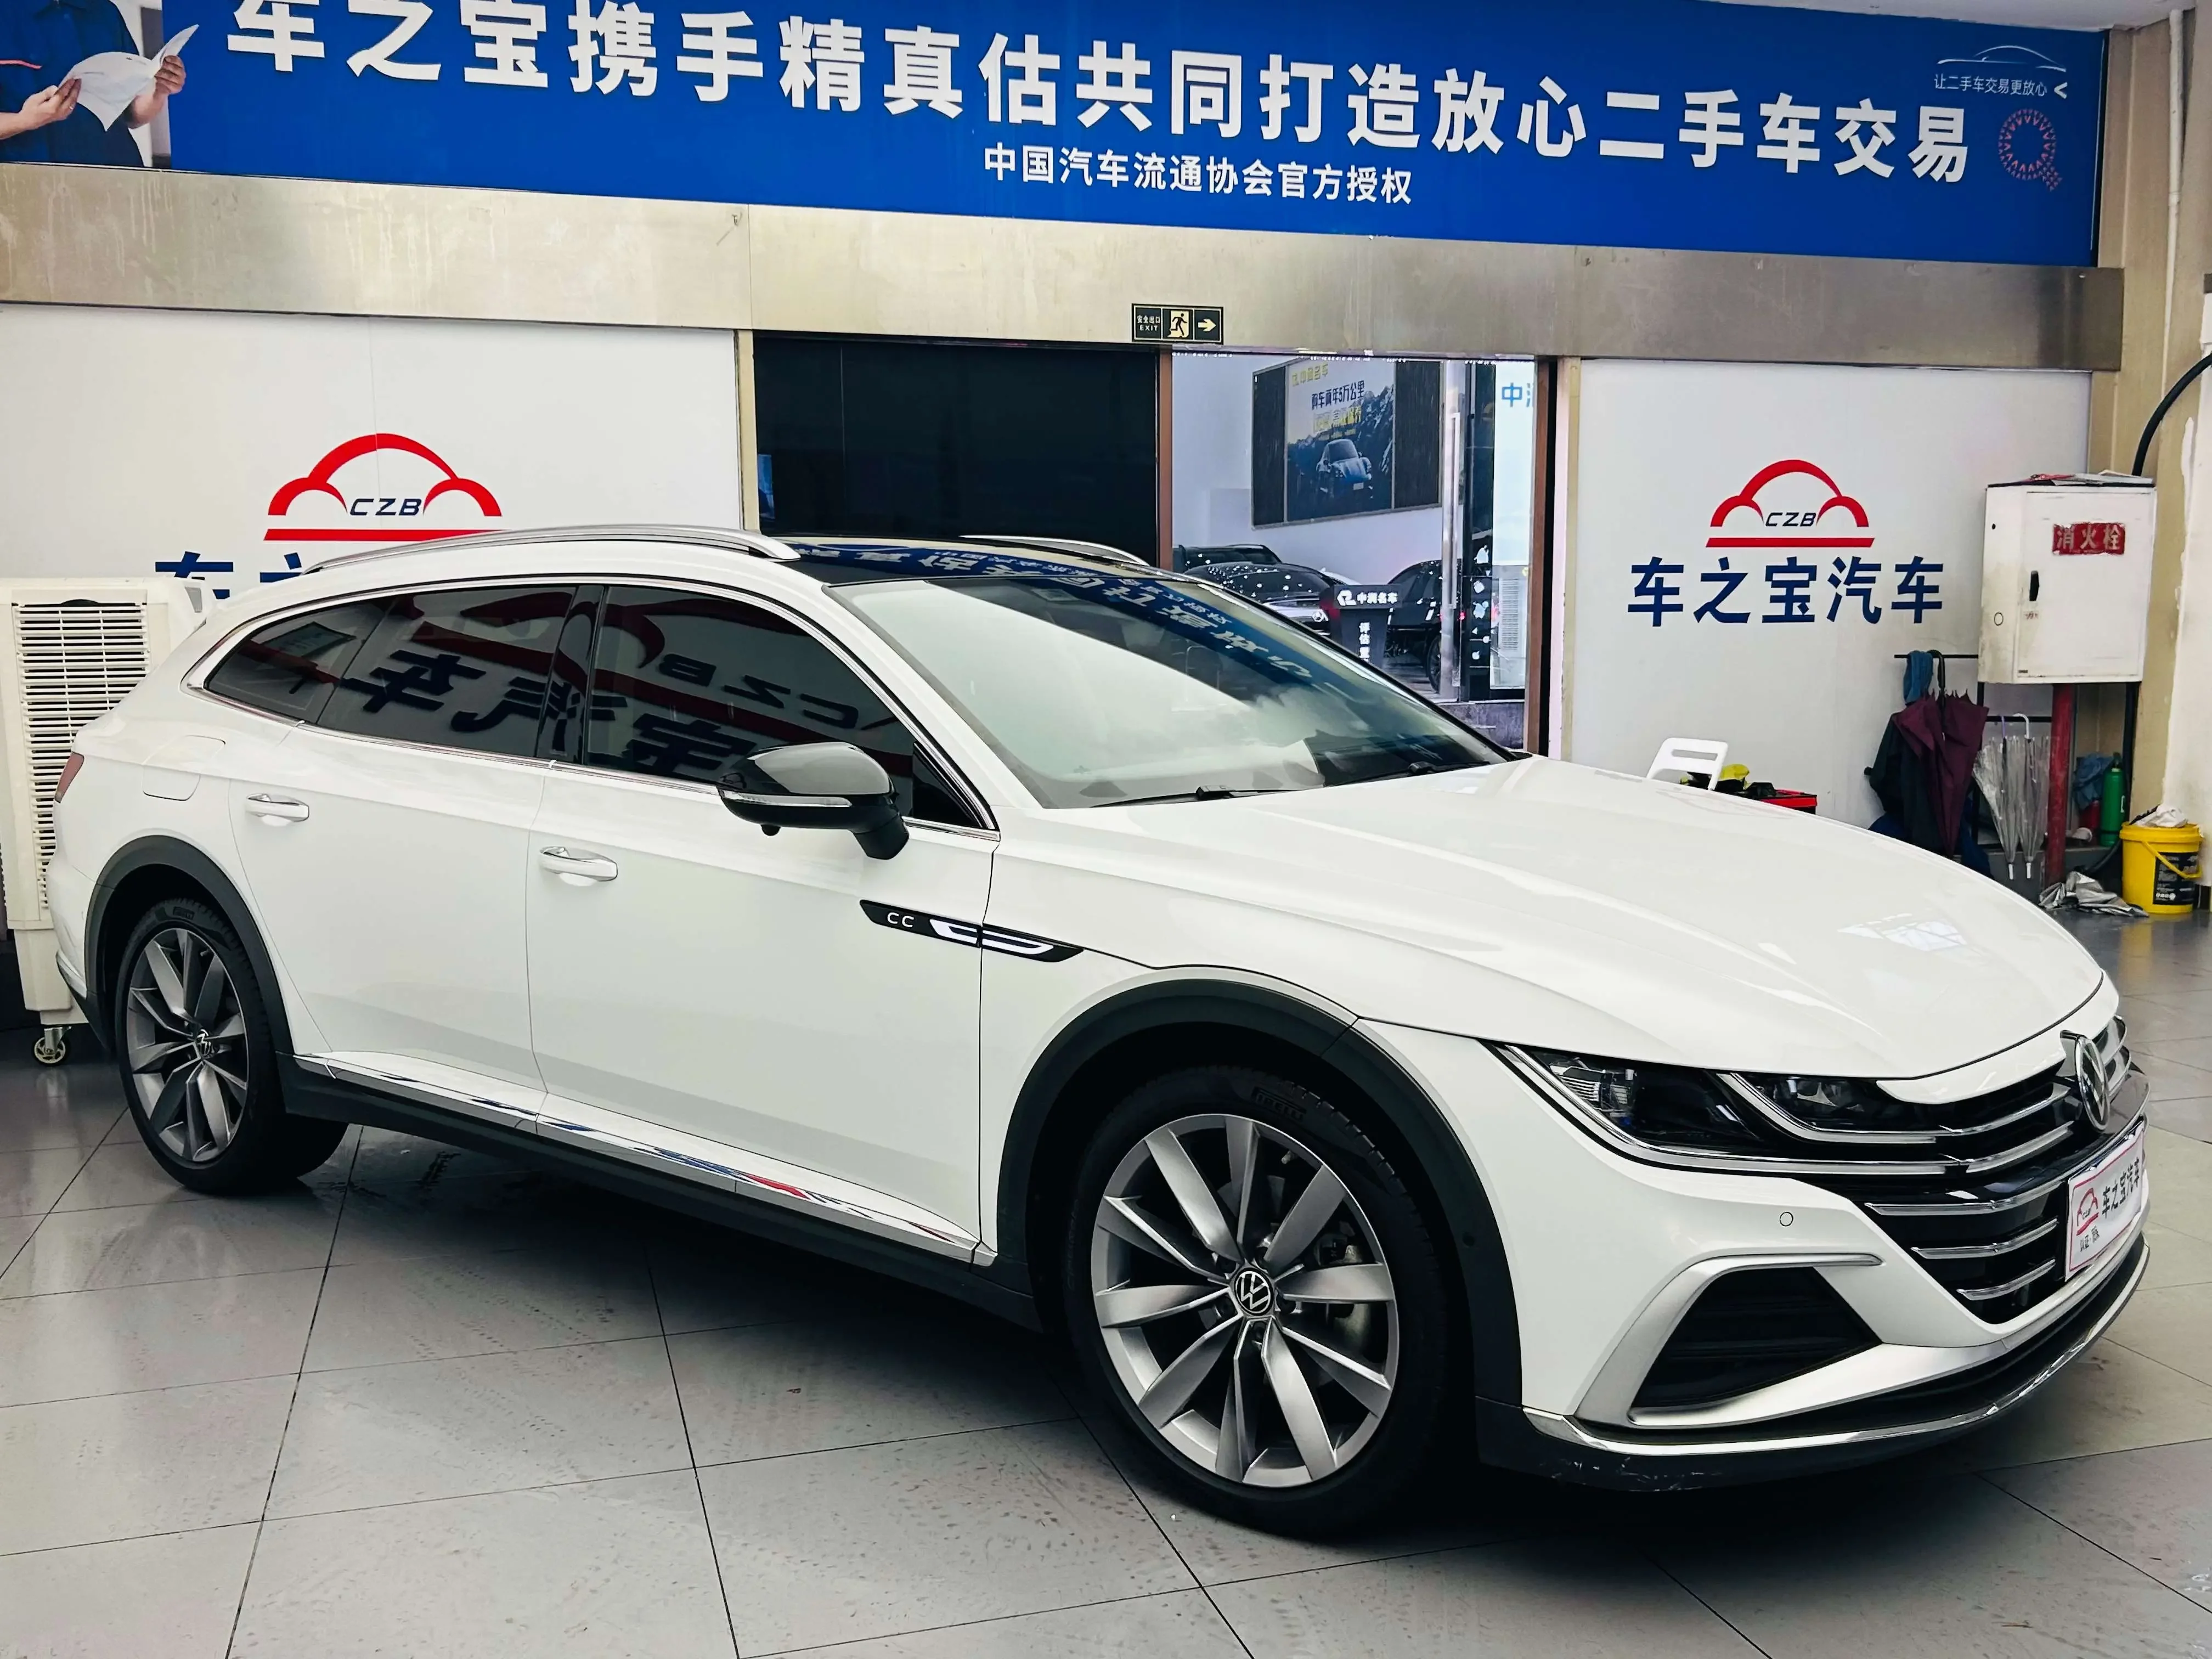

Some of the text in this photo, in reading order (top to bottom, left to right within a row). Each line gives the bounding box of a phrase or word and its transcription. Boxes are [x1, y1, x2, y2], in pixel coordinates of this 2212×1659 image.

[227, 0, 1968, 183] 车之宝携手精真估共同打造放心二手车交易
[1934, 74, 2047, 97] 让二手车交易更放心
[984, 142, 1414, 205] 中国汽车流通协会官方授权
[1137, 315, 1160, 324] 安全出口
[349, 498, 422, 516] CZB
[1765, 512, 1816, 527] CZB
[2057, 524, 2120, 550] 消火栓
[1628, 556, 1944, 627] 车之宝汽车
[887, 912, 915, 928] CC
[2102, 1156, 2140, 1218] 车之宝汽车
